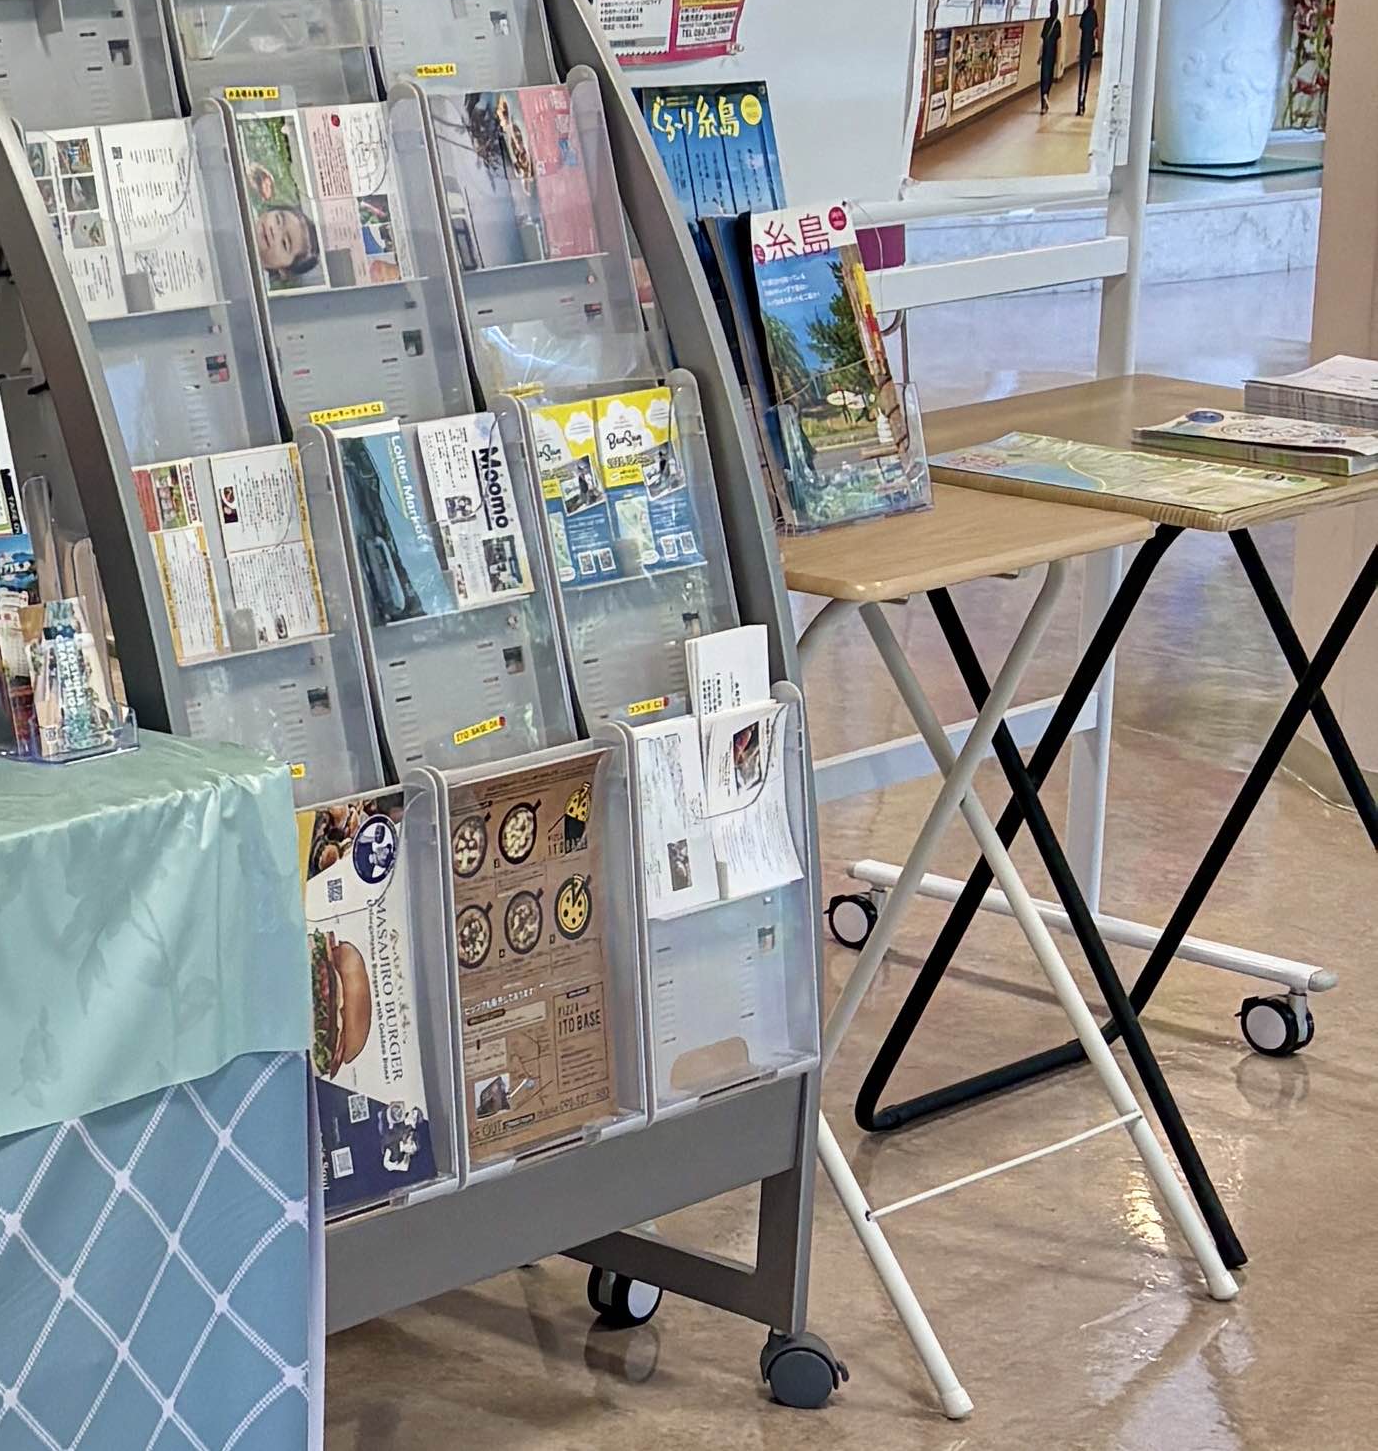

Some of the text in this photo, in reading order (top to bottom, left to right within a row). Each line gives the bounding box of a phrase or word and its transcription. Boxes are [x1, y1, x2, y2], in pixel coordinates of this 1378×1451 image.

[764, 212, 830, 263] 糸島
[376, 897, 404, 1082] MASAJIRO BURGER
[557, 1009, 602, 1037] ITO BASE
